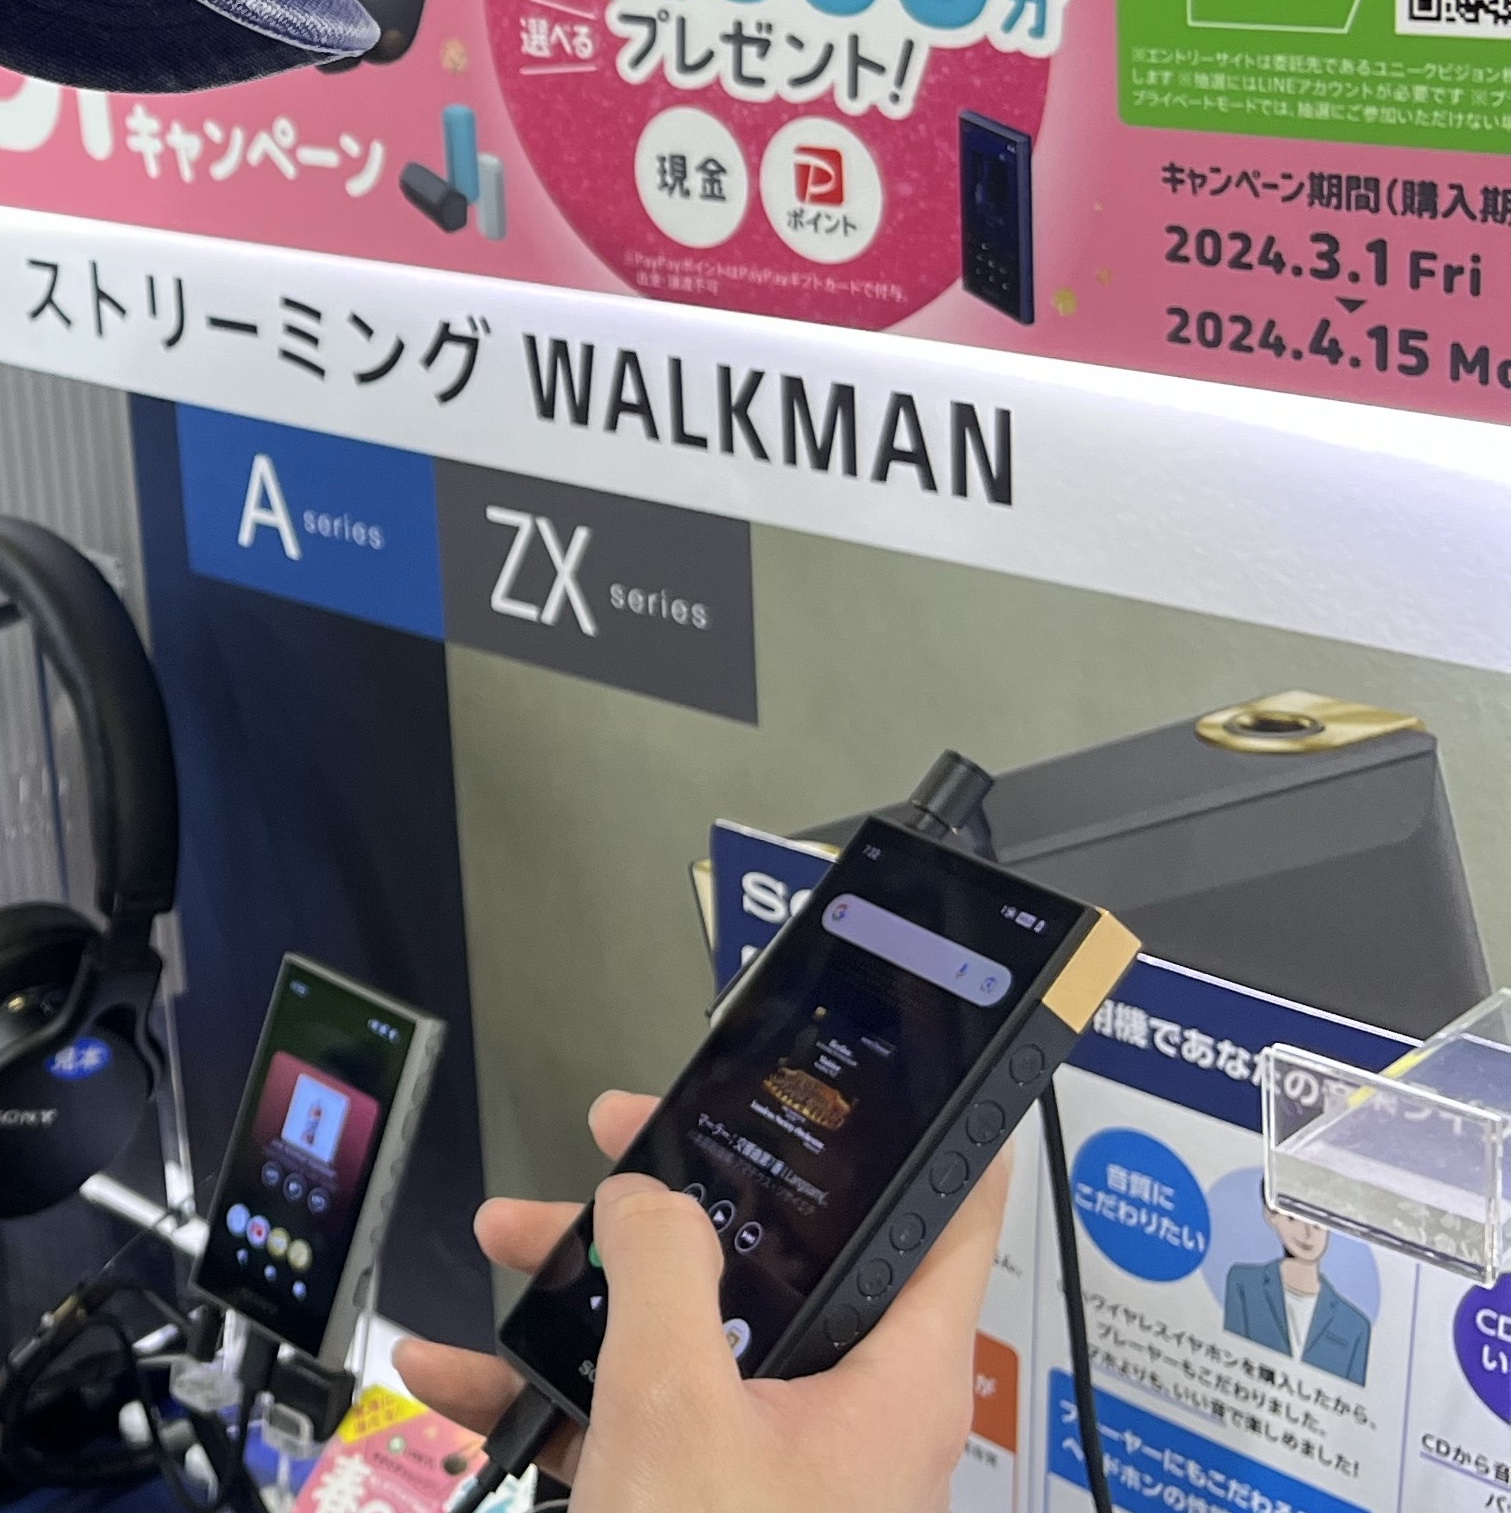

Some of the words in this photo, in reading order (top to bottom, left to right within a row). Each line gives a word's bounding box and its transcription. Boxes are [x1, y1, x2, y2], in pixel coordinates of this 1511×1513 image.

[519, 17, 595, 58] 選べる
[124, 103, 385, 198] キャンペーン
[656, 153, 727, 202] 現金
[786, 206, 857, 237] ポイント
[1164, 224, 1388, 287] 2024.3.1
[1408, 250, 1483, 298] Fri
[1165, 306, 1430, 377] 2024.4.15
[26, 259, 492, 405] ストリーミング
[522, 333, 1016, 508] WALKMAN
[236, 452, 301, 563] A
[302, 509, 385, 550] series
[485, 503, 598, 638] ZX
[608, 579, 710, 632] series
[1073, 1183, 1206, 1255] こだわりたい
[1105, 1162, 1176, 1210] 音質に
[1057, 1280, 1378, 1431] ワイヤレスイヤホンを購入したから、
